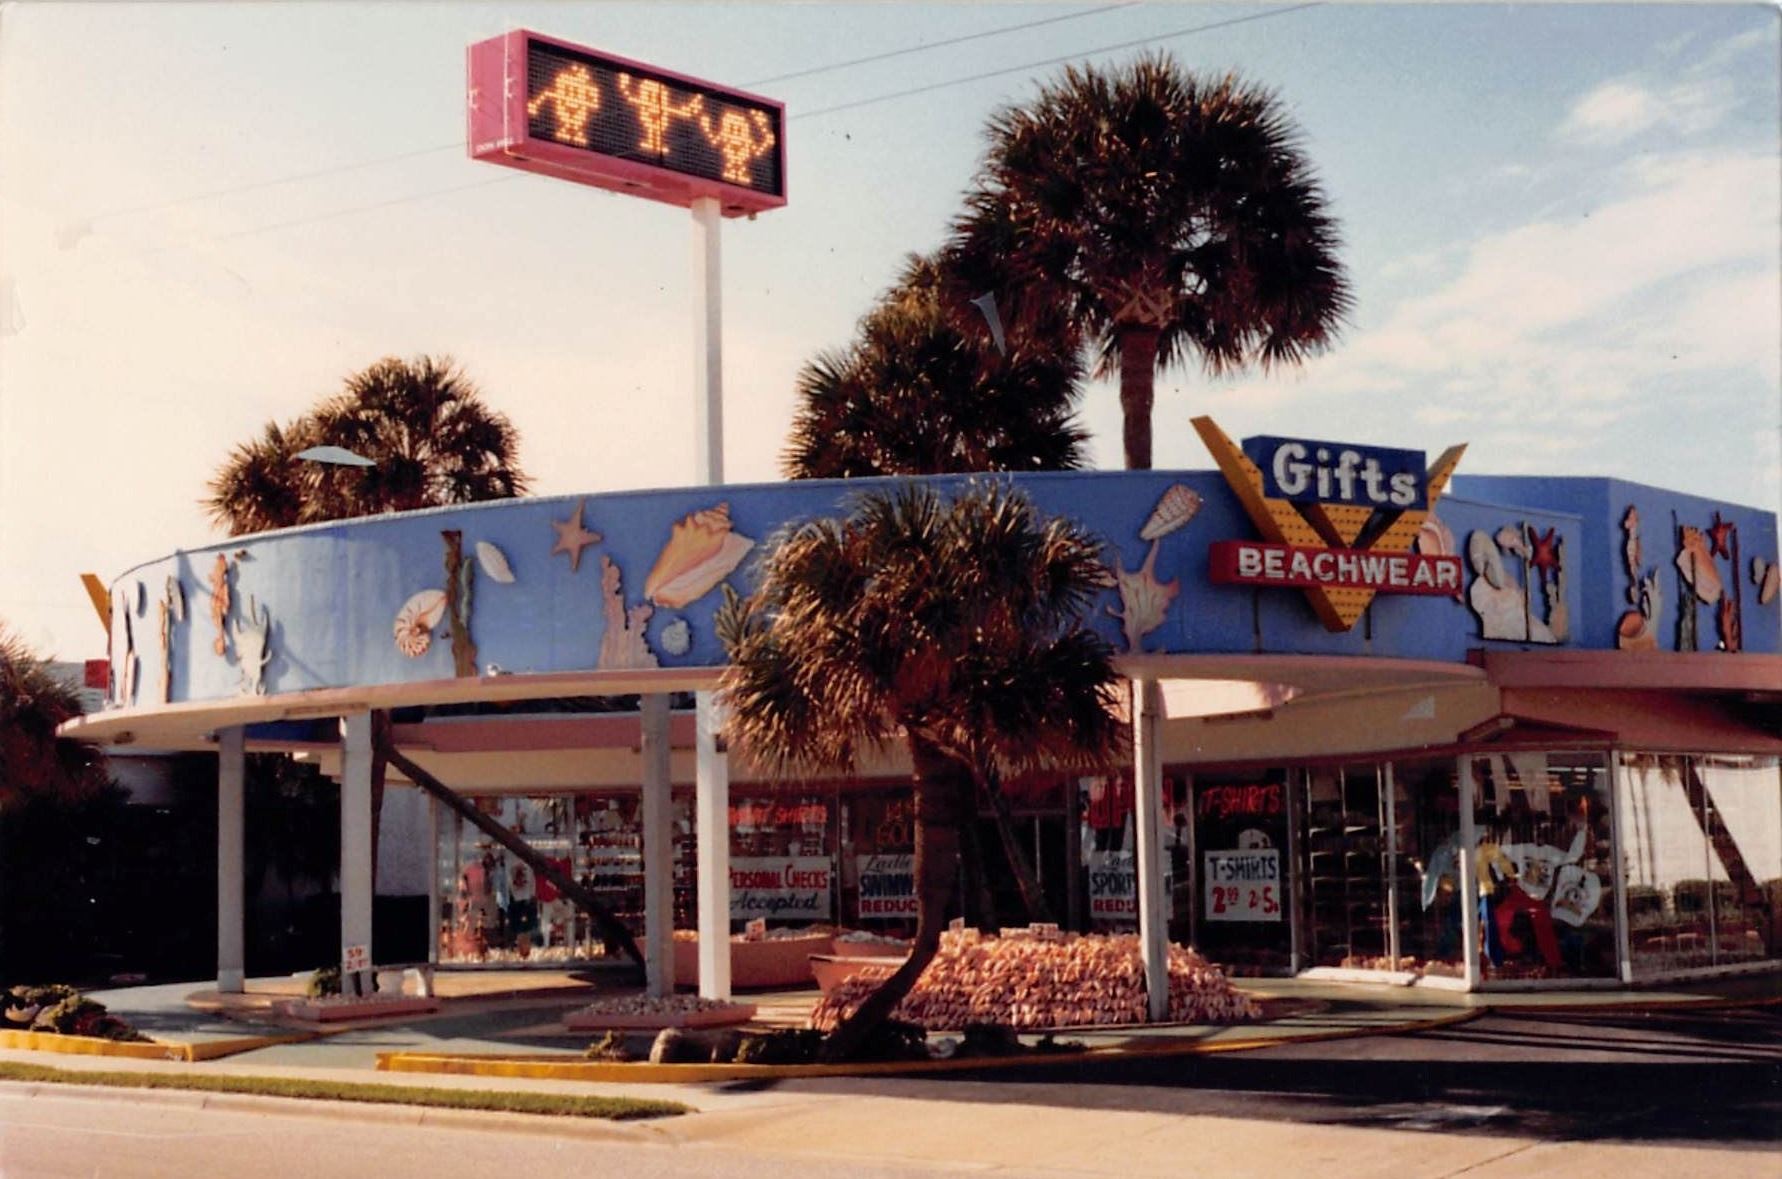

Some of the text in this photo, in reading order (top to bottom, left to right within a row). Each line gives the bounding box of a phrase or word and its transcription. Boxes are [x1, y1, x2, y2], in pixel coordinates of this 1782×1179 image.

[1272, 442, 1417, 506] Gifts
[1238, 547, 1458, 589] BEACHWEAR
[1201, 785, 1280, 817] T-SHIRTS
[785, 863, 828, 889] CHECKS
[1208, 856, 1277, 881] T-SHIRTS
[729, 890, 821, 915] Accepted
